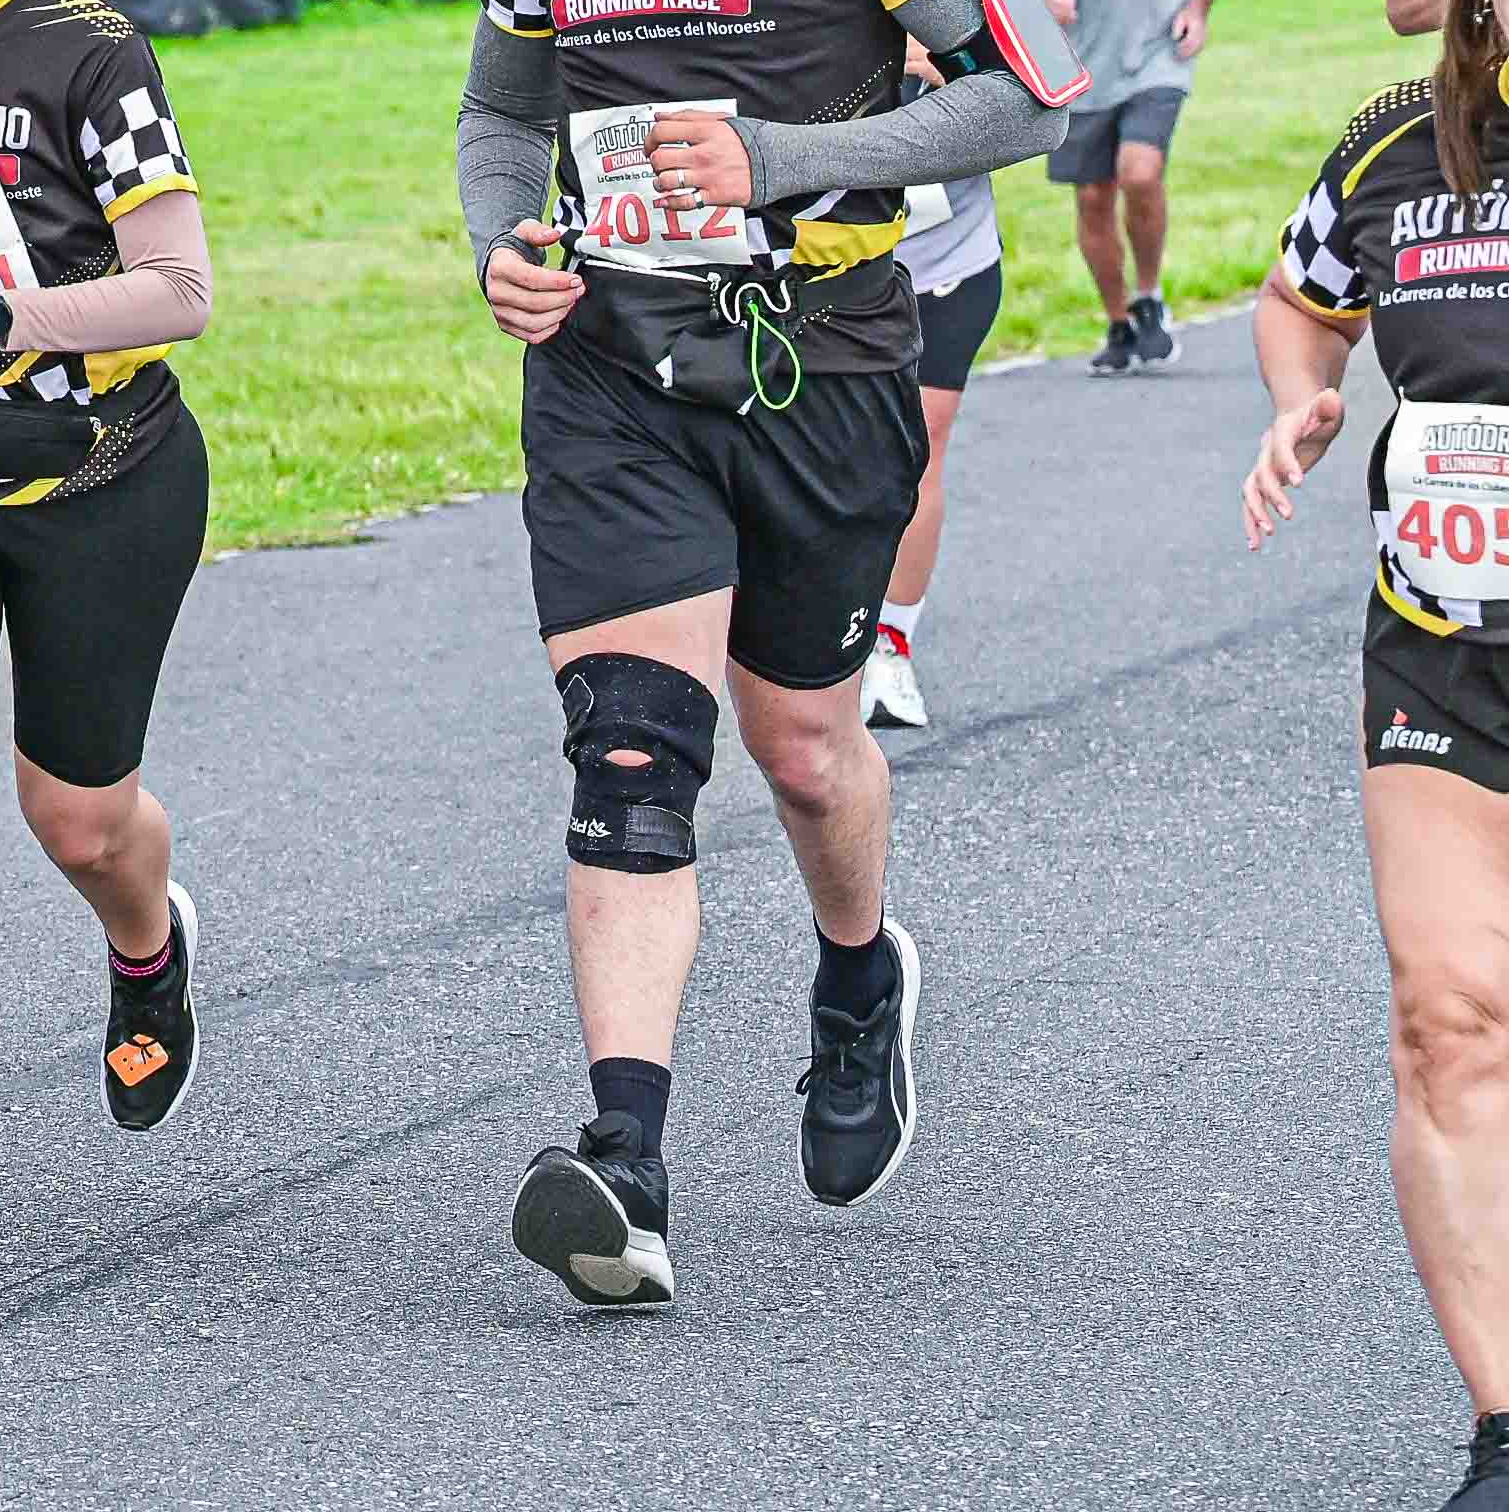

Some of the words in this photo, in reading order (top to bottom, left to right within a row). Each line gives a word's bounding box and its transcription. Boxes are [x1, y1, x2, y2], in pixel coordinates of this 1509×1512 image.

[594, 29, 612, 44] de
[612, 28, 634, 42] los
[635, 23, 682, 40] Clubes
[683, 21, 705, 37] del
[707, 18, 776, 35] Noroeste
[612, 150, 651, 169] RUNNIN
[6, 185, 43, 200] oeste
[585, 193, 736, 248] 4012
[1392, 287, 1443, 304] Carrera
[1446, 283, 1468, 299] de
[1469, 282, 1495, 299] los
